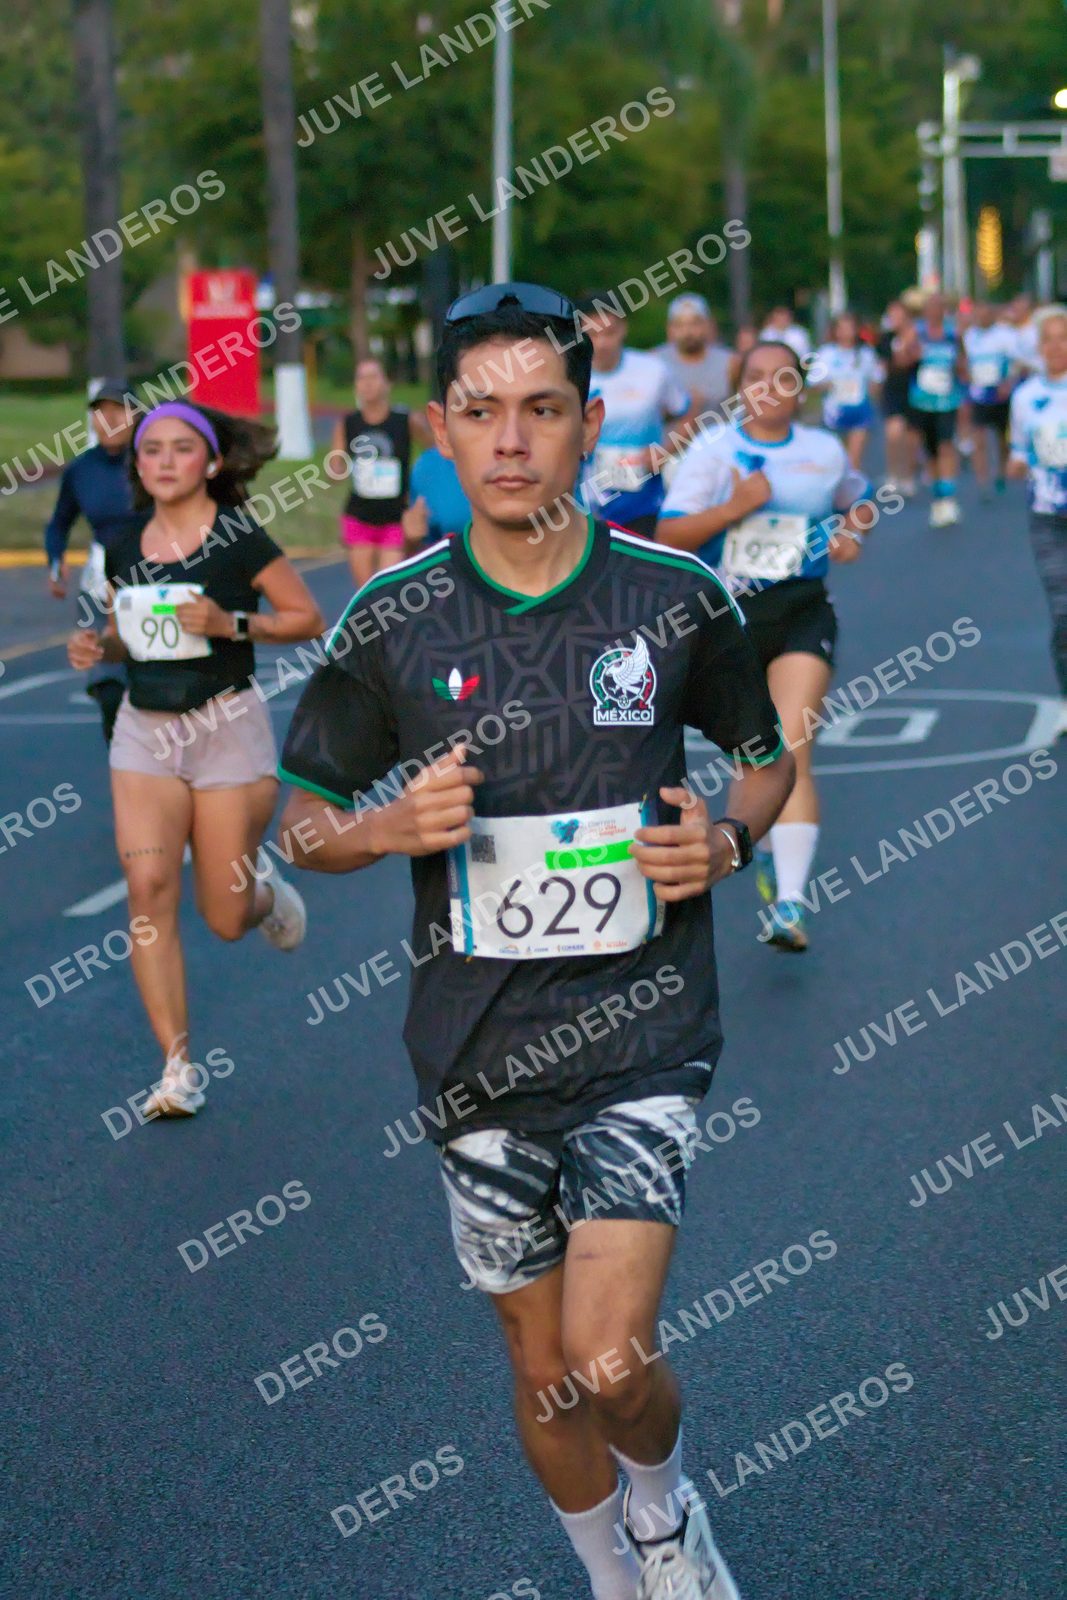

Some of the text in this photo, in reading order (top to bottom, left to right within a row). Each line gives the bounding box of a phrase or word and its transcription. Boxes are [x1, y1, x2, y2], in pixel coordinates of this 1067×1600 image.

[141, 616, 179, 649] 90
[597, 707, 650, 721] MÉXICO
[496, 872, 622, 939] 629
